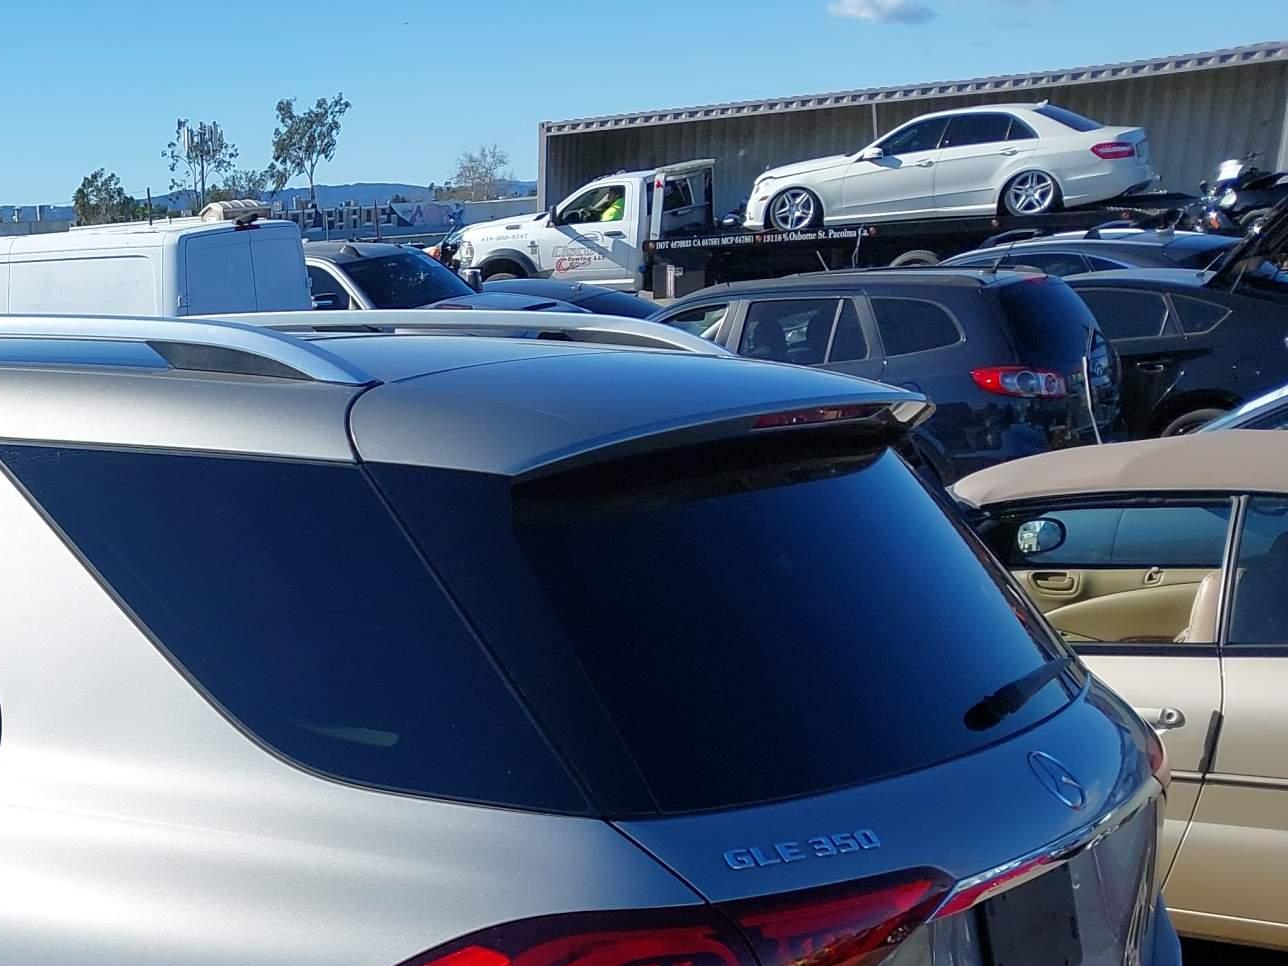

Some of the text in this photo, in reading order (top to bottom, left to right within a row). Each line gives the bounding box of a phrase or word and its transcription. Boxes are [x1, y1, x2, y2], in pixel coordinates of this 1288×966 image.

[790, 231, 817, 240] Osborne
[818, 229, 827, 239] St.
[829, 228, 856, 238] Pacoima
[656, 241, 669, 249] DOT
[693, 239, 700, 247] CA
[723, 829, 881, 870] GLE 350
